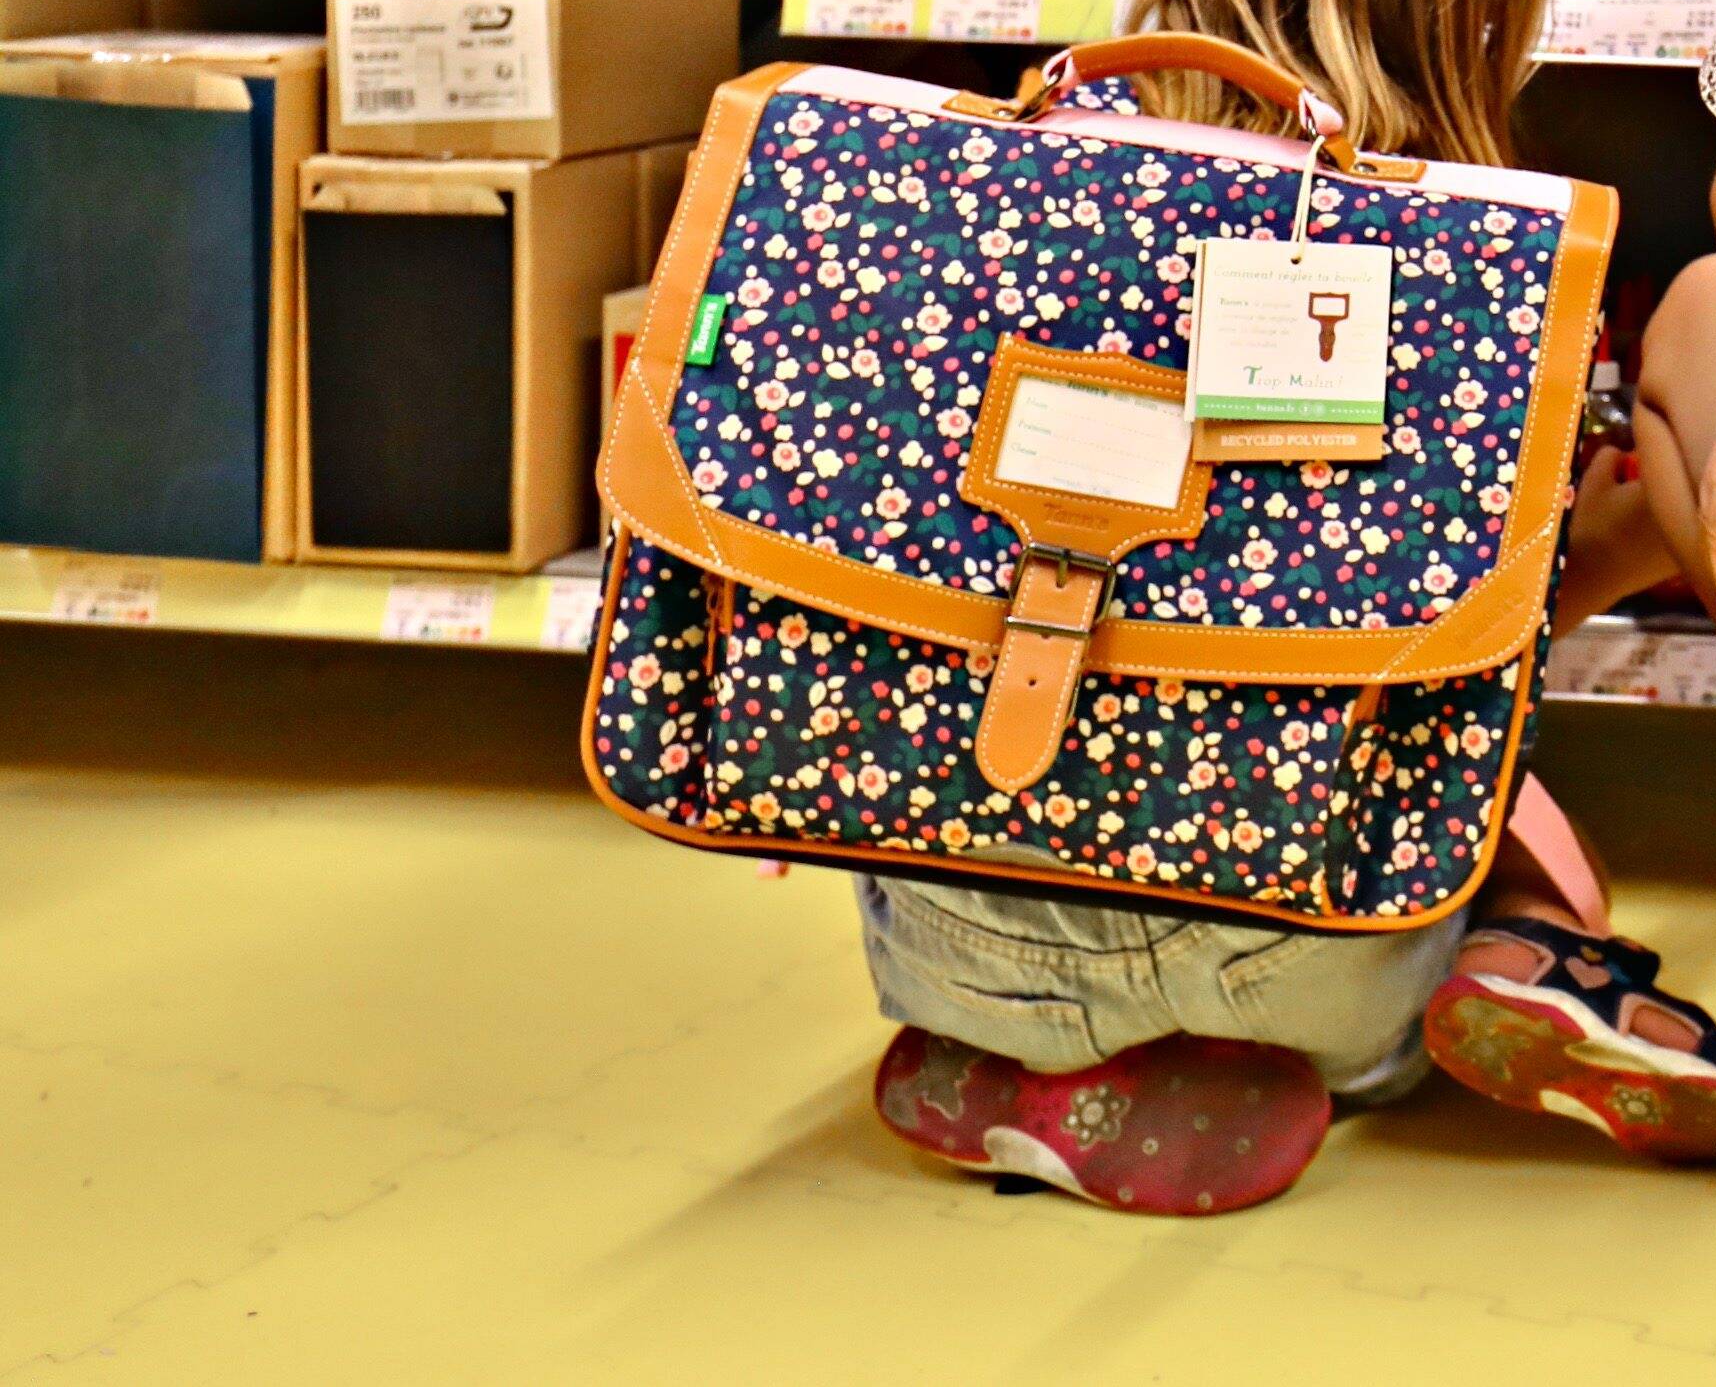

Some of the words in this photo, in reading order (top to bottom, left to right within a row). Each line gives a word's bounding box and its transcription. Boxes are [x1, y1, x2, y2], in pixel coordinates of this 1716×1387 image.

[1213, 265, 1274, 281] Comment
[1243, 365, 1282, 390] Trop
[1220, 434, 1286, 448] RECYCLED
[1287, 434, 1358, 447] POLYESTER
